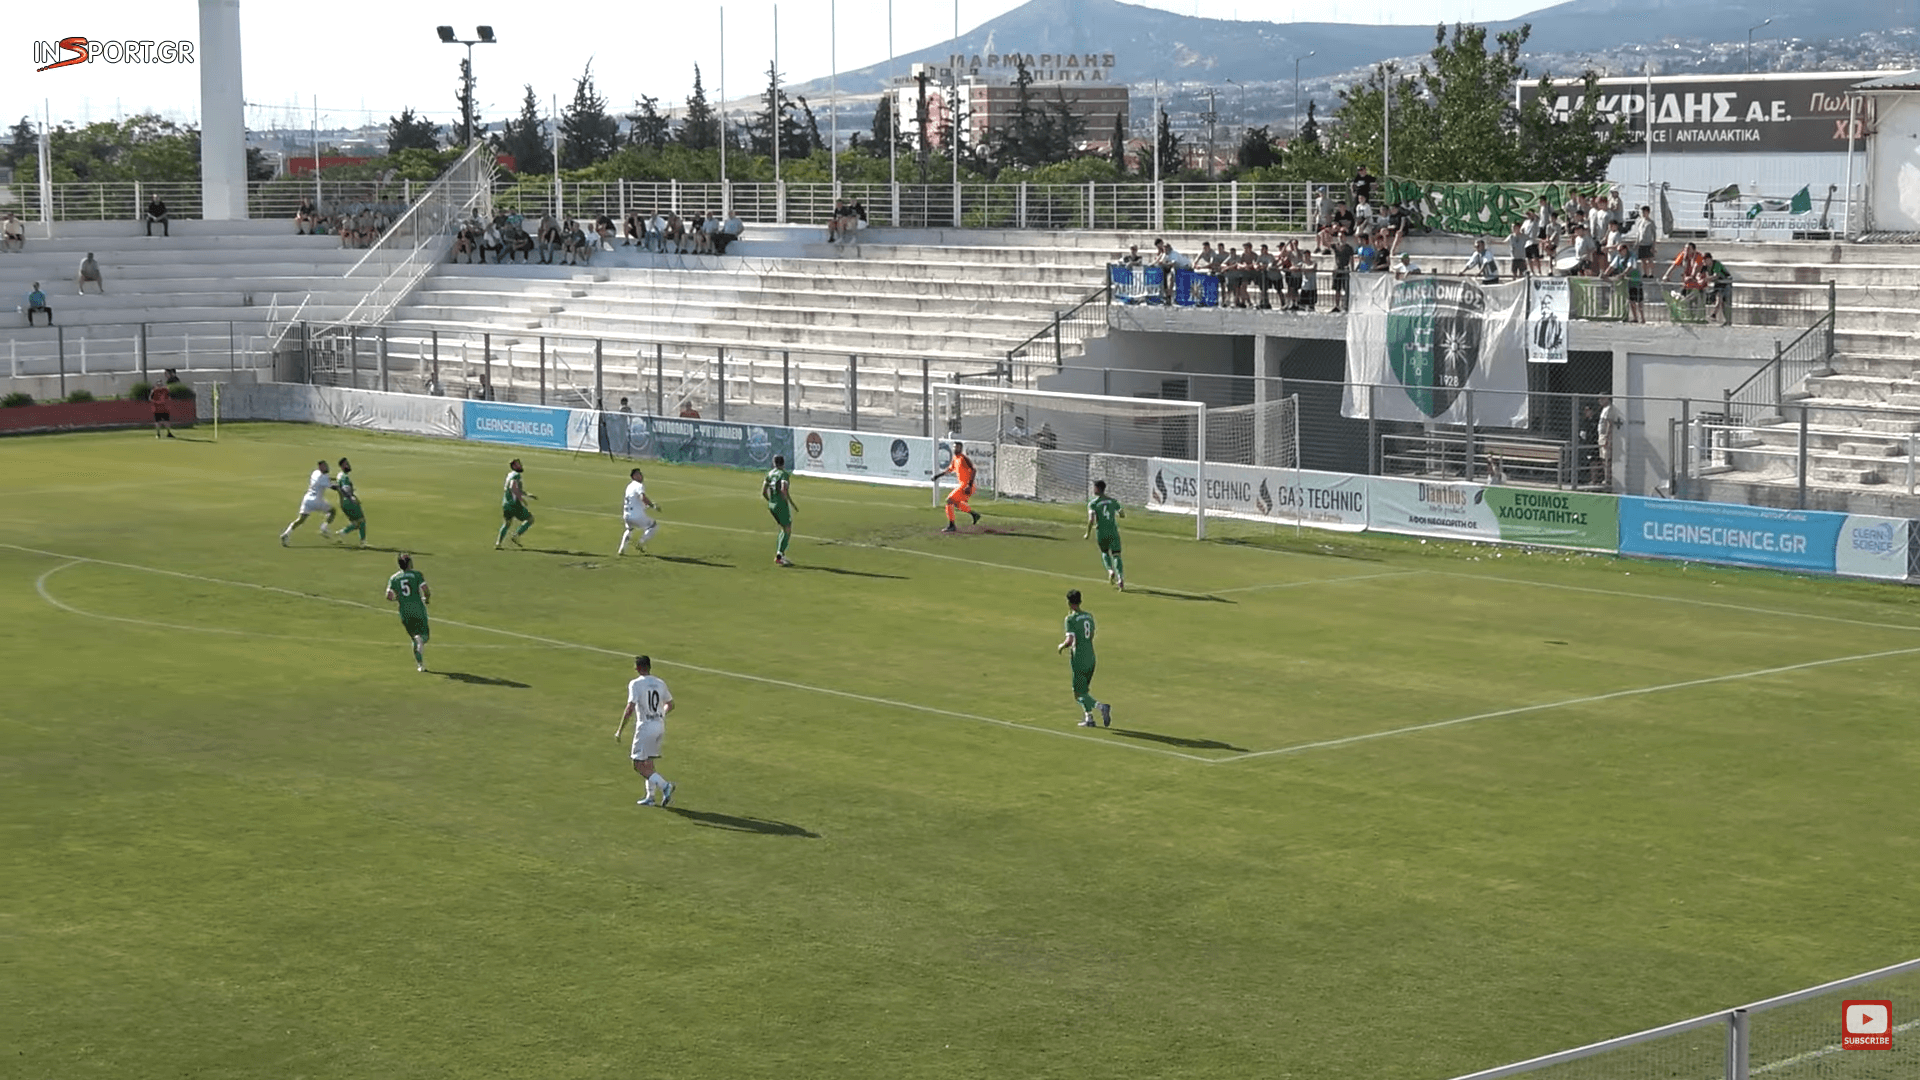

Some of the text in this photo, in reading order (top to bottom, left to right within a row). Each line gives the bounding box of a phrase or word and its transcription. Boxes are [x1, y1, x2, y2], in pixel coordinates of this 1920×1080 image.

[950, 54, 1116, 68] ΜΑΡΜΑΡΙΔΗΣ
[1676, 129, 1760, 142] ΑΝΤΑΛΛΑΚΤΙΚΑ
[1440, 375, 1459, 387] 1928
[476, 417, 554, 437] CLEANSCIENCE.GR
[1173, 477, 1197, 497] GAS
[1419, 483, 1467, 506] Dianthos
[1279, 485, 1363, 512] GAS TECHNIC
[1515, 493, 1569, 510] ΕΤΟΙΜΟΣ
[1103, 504, 1110, 520] 4
[1499, 506, 1588, 525] ΧΛΟΟΤΑΠΗΤΑΣ
[1642, 521, 1807, 553] CLEANSCIENCE.GR
[400, 579, 411, 597] 5
[1083, 620, 1091, 639] 8
[648, 689, 660, 713] 10
